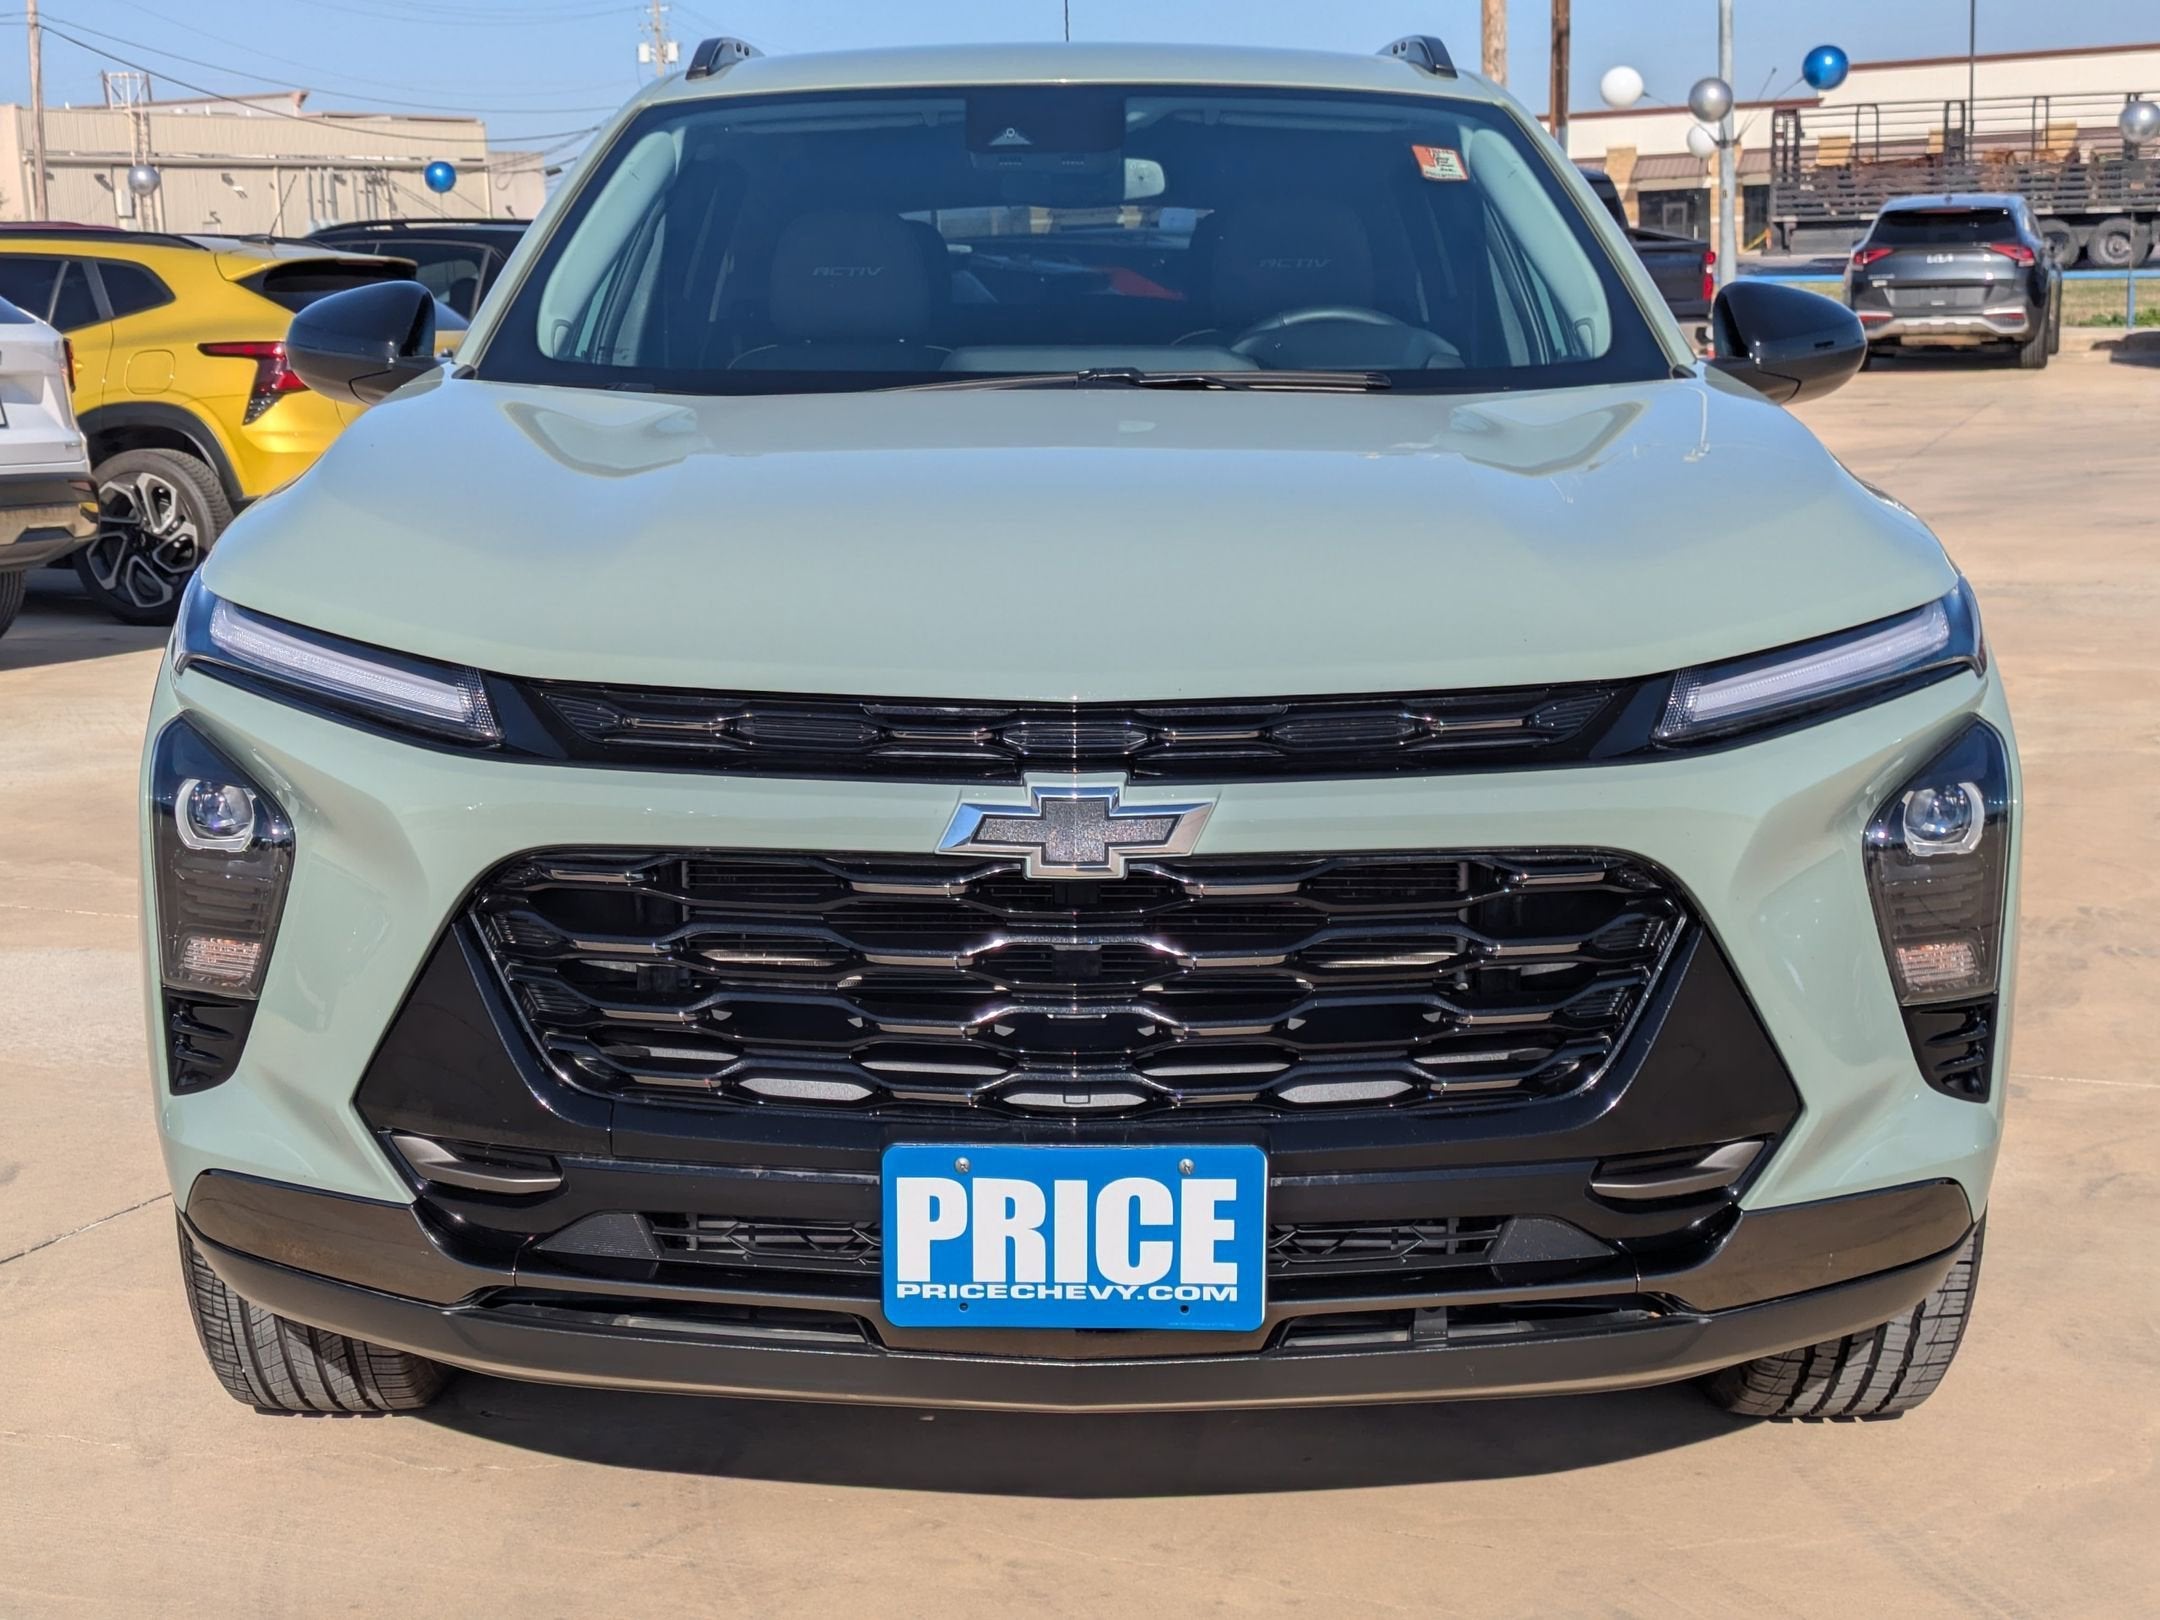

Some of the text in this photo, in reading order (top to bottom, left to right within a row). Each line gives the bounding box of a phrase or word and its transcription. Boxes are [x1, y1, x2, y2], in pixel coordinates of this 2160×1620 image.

[1257, 257, 1333, 269] ACTIV
[811, 265, 885, 277] ACTIV
[896, 1177, 1238, 1285] PRICE
[896, 1283, 1238, 1302] PRICECHEVY.COM
